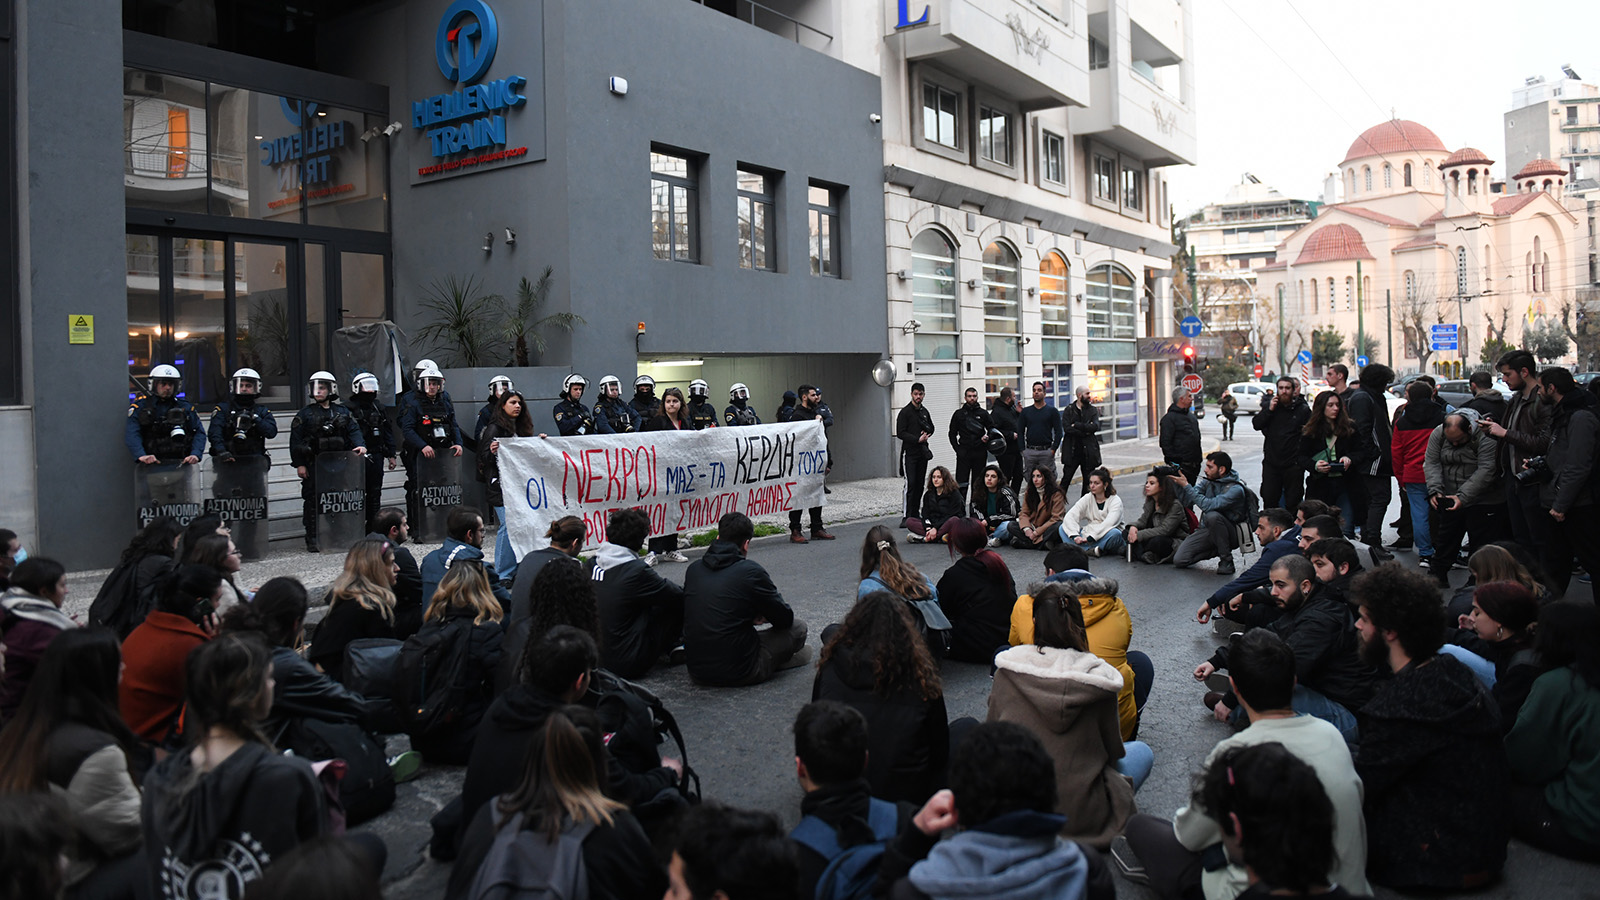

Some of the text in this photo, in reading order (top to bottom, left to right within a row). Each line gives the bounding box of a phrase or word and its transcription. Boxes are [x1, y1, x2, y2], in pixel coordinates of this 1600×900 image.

[411, 75, 526, 129] HELLENIC
[426, 115, 506, 157] TRAIN
[1183, 379, 1201, 390] STOP
[526, 477, 548, 510] ΟΙ
[562, 445, 657, 507] ΝΕΚΡΟΙ
[733, 432, 796, 485] ΚΕΡΔΗ
[798, 450, 826, 476] ΤΟΥΣ
[320, 490, 365, 504] ΑΣΤΥΝΟΜΙΑ
[424, 495, 461, 506] POLICE
[746, 482, 798, 518] ΑΘΗΝΑΣ
[207, 498, 265, 511] ΑΣΤΥΝΟΜΙΑ
[323, 501, 363, 514] POLICE
[219, 509, 263, 521] OLICE
